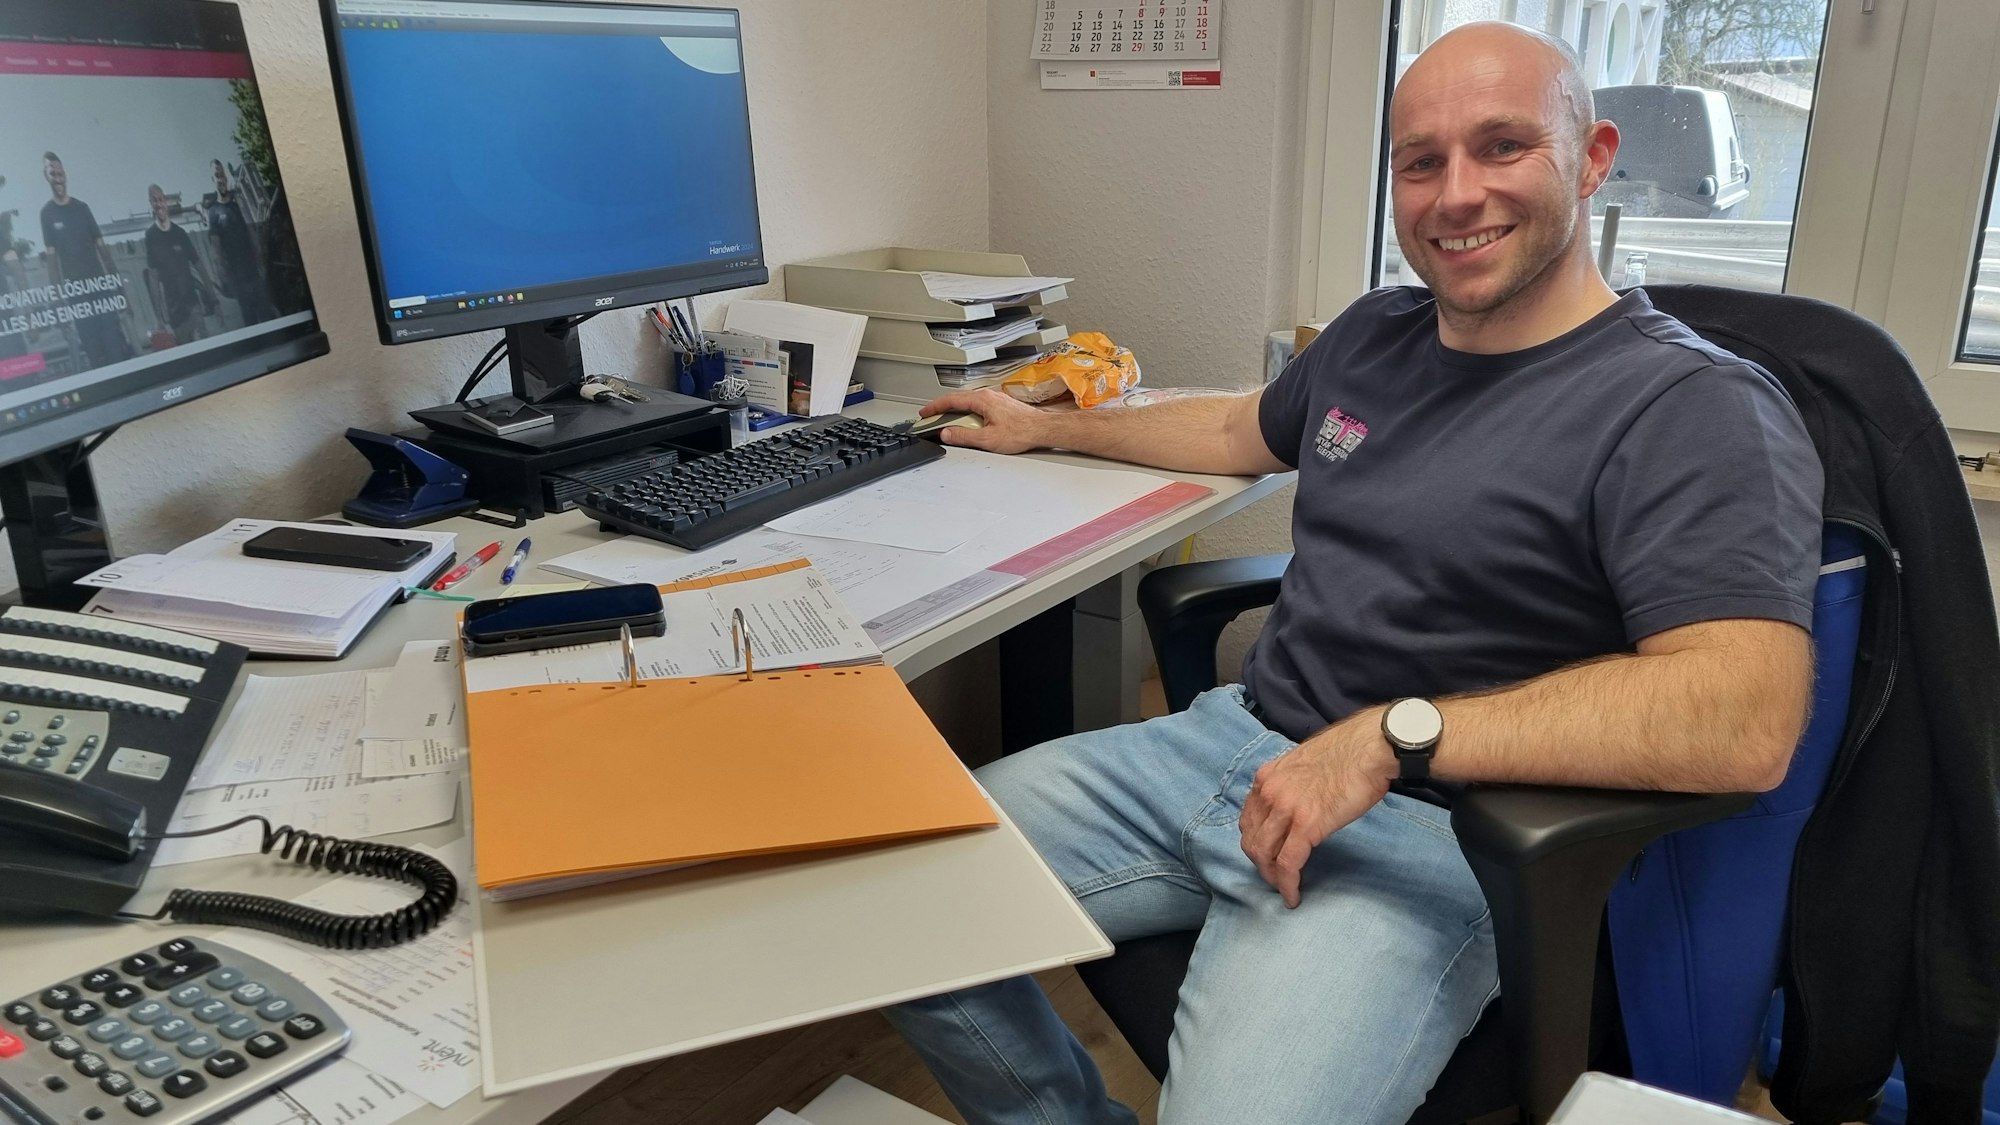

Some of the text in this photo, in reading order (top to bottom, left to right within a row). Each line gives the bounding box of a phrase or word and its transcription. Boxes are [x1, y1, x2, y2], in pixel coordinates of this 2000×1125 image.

[1045, 0, 1055, 9] 18
[1044, 6, 1208, 20] 19 5 6 7 8 9 10 11
[1043, 18, 1207, 31] 20 12 13 14 15 16 17 18
[1042, 30, 1207, 41] 21 19 20 21 22 23 24 25
[1040, 42, 1206, 52] 22 26 27 28 29 30 31 1
[57, 273, 122, 299] LÖSUNGEN
[594, 296, 615, 306] acer
[30, 310, 57, 330] AUS
[56, 301, 94, 324] EINER
[95, 294, 127, 314] HAND
[162, 386, 183, 400] acer
[232, 523, 258, 532] 11
[90, 572, 122, 584] 10
[90, 604, 114, 614] 7
[178, 986, 200, 998] 3
[238, 983, 265, 997] 00
[203, 1001, 225, 1013] 2
[266, 1000, 288, 1012] 0
[97, 1021, 120, 1032] 9
[138, 1004, 208, 1046] 4 5 6
[120, 1037, 144, 1049] 8
[422, 1038, 474, 1068] nvent
